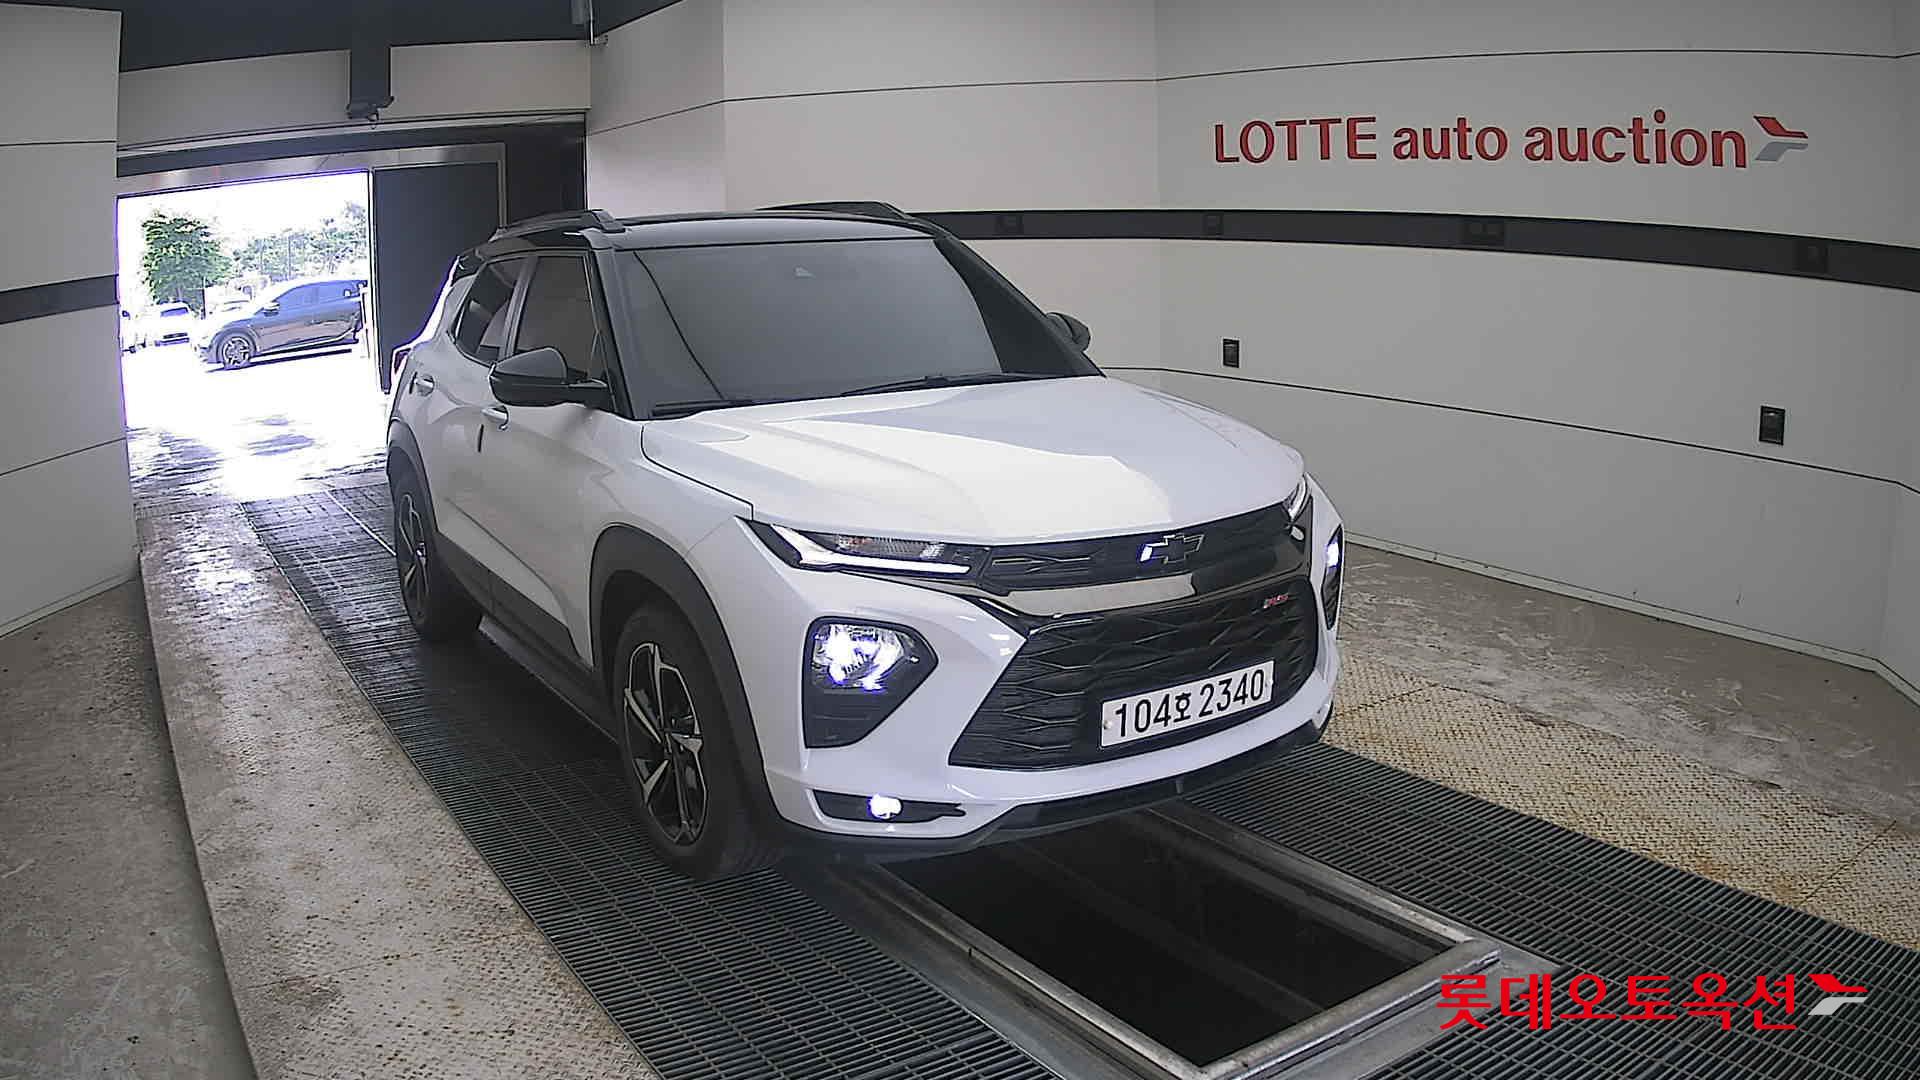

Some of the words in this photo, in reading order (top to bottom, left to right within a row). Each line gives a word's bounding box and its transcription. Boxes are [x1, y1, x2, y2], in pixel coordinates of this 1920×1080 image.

[1214, 117, 1377, 163] LOTTE
[1393, 117, 1508, 161] auto
[1525, 109, 1746, 168] auction
[1115, 692, 1191, 737] 104호
[1198, 669, 1264, 717] 2340
